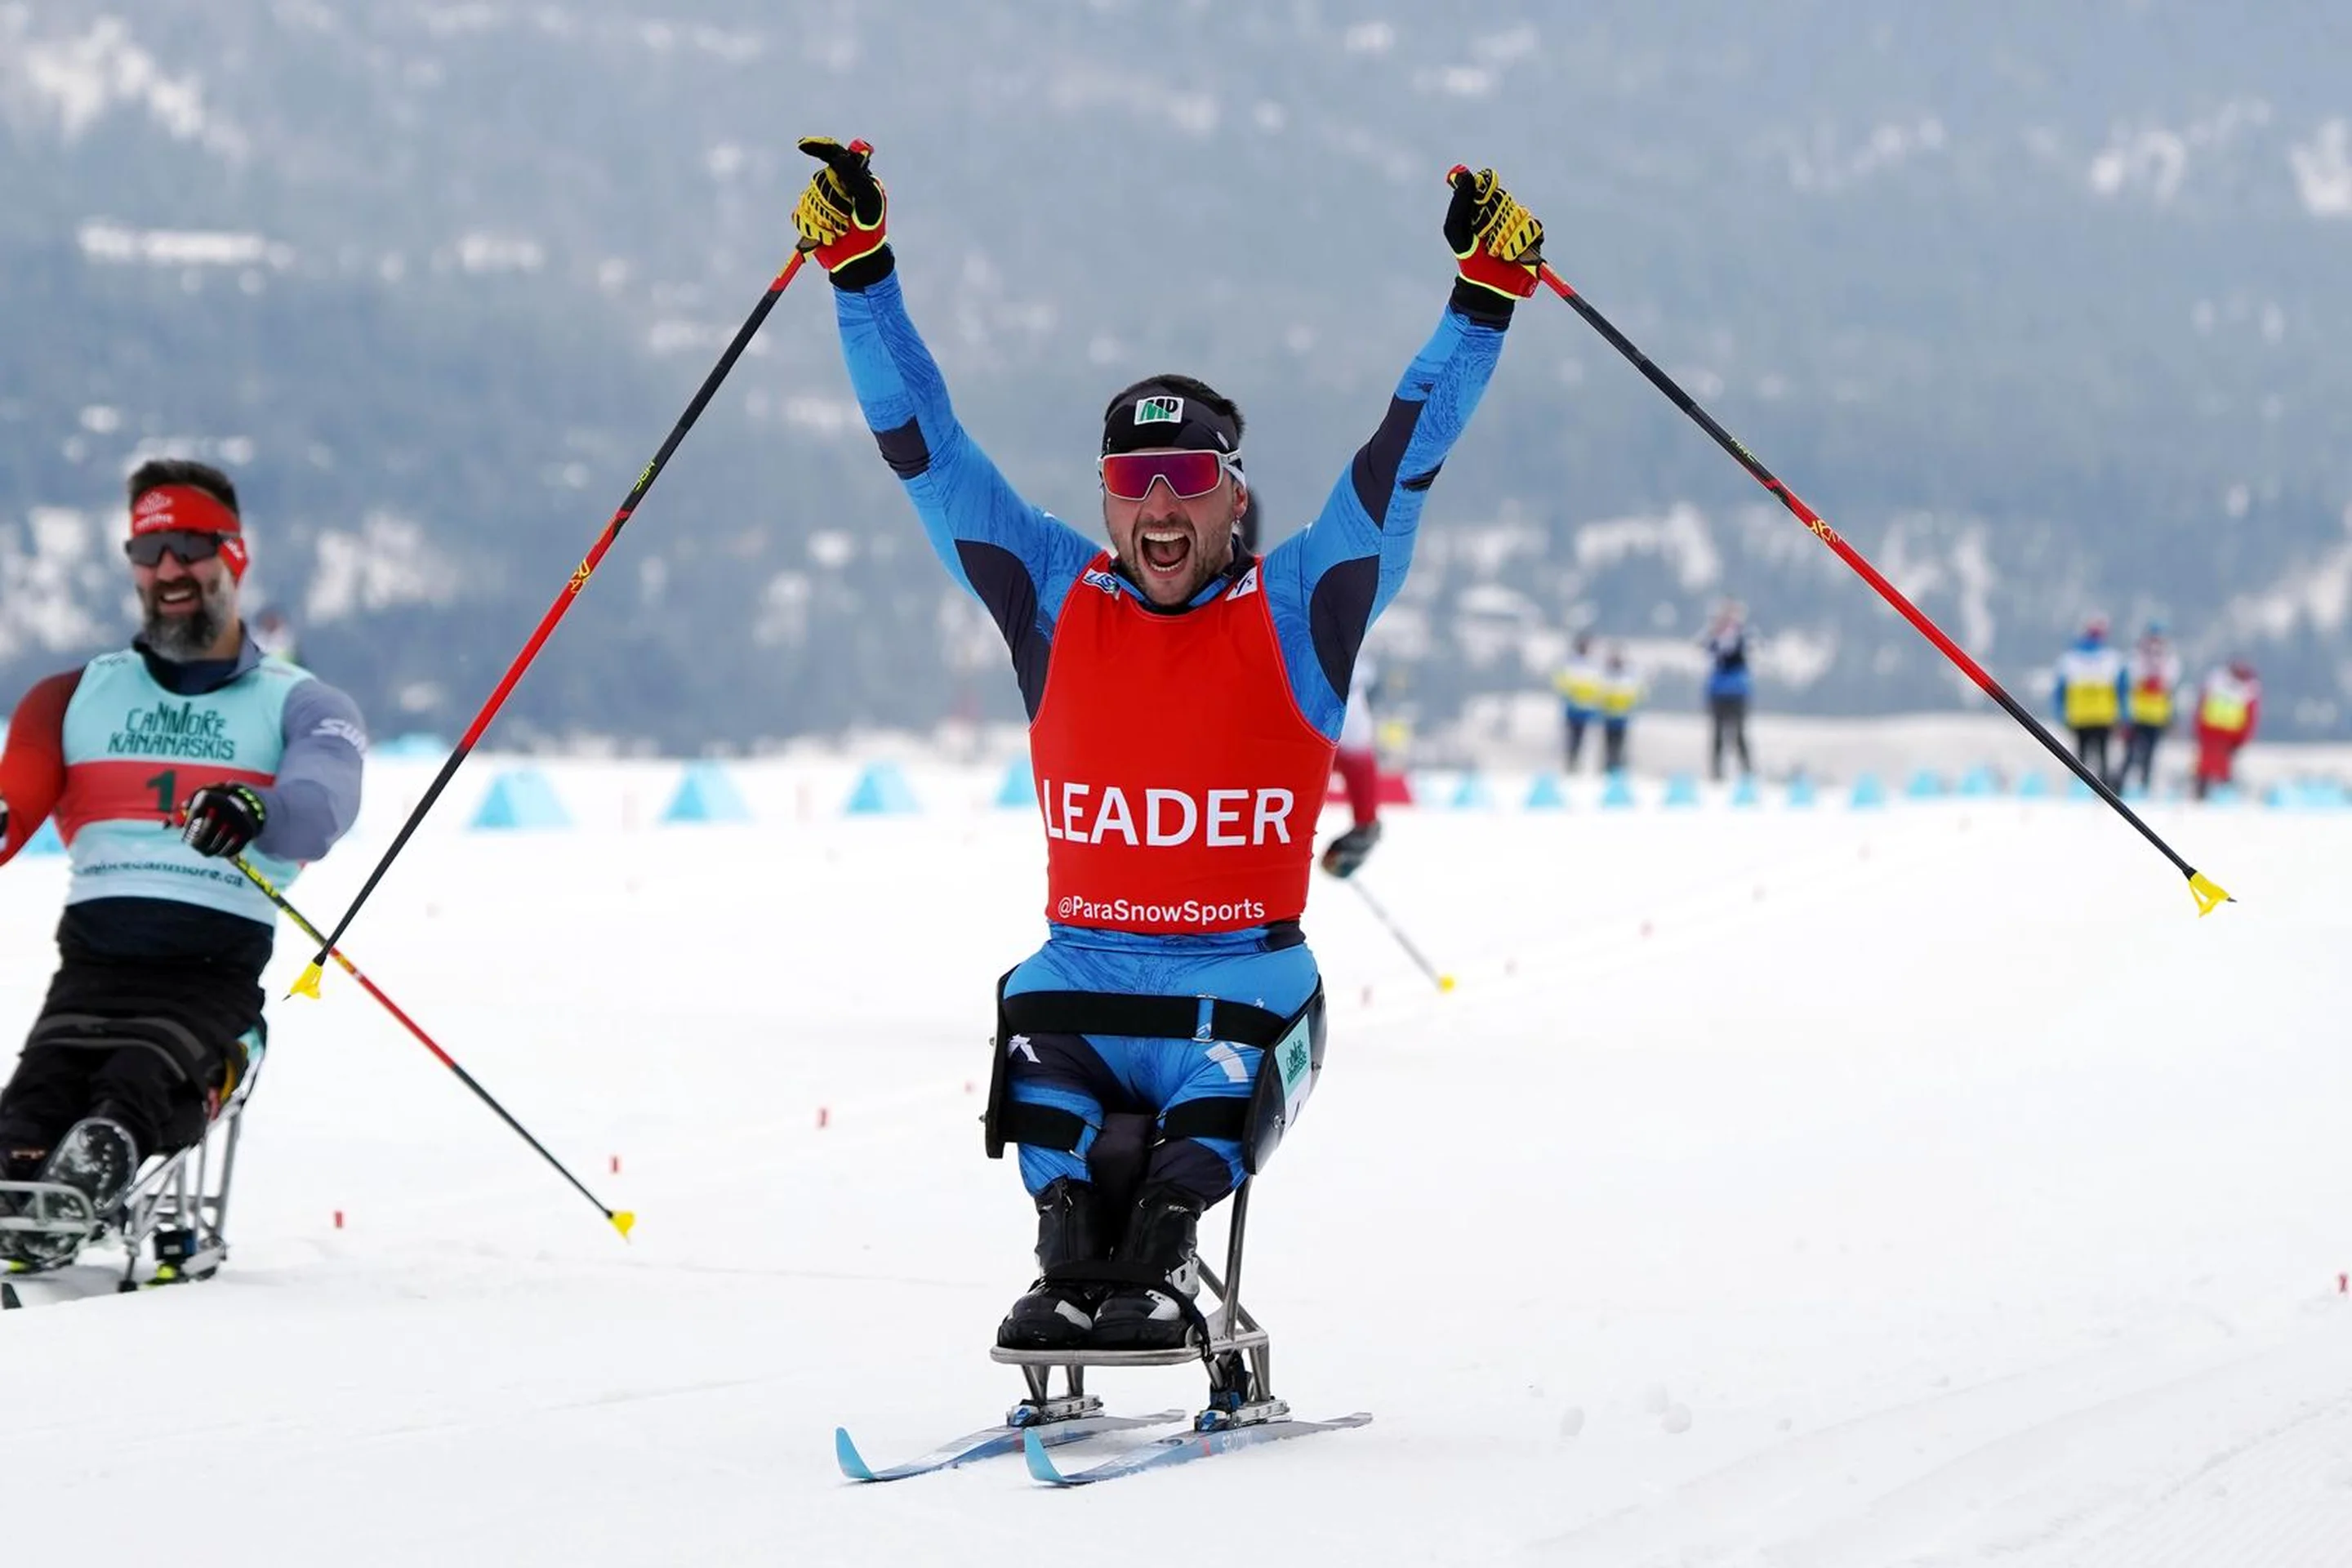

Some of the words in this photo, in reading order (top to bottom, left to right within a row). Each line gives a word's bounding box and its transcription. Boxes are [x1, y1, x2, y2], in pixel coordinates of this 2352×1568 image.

[126, 701, 226, 739] CANMORE
[107, 730, 236, 761] KANANASKIS
[1043, 779, 1294, 847] LEADER
[1058, 895, 1266, 925] @ParaSnowSports
